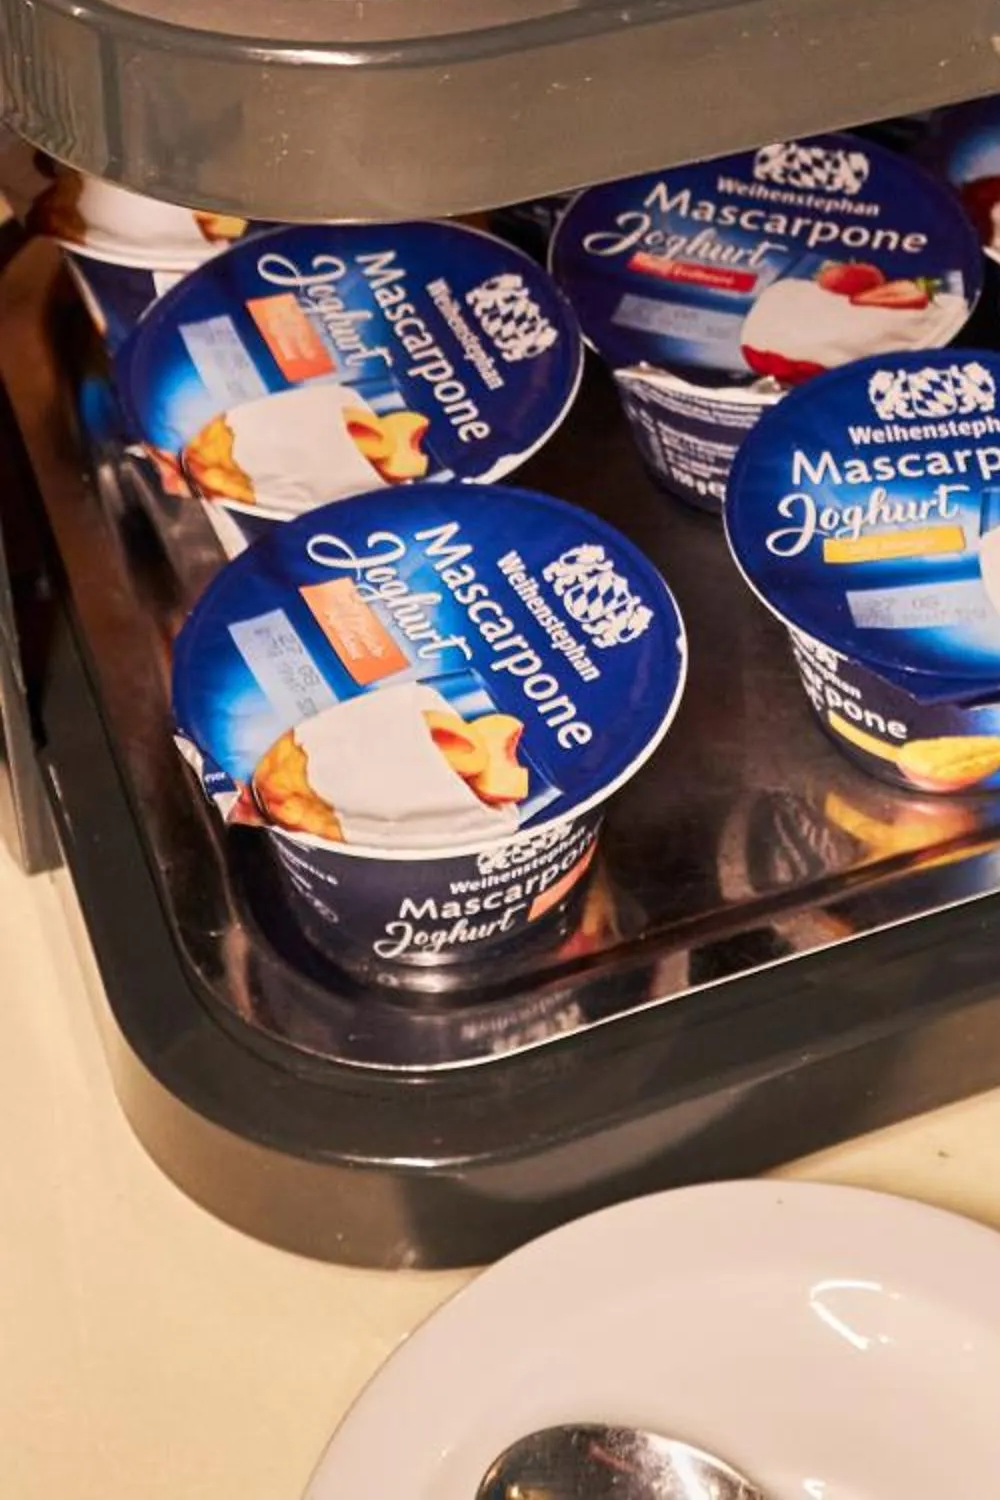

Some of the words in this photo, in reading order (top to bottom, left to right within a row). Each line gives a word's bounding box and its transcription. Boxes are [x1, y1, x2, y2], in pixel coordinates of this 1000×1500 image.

[583, 210, 789, 269] Joghurt
[642, 181, 929, 255] Mascarpone
[717, 176, 881, 218] Weihenstephan
[256, 252, 393, 370] Joghurt
[354, 250, 491, 444] Mascarpone
[765, 484, 971, 558] Joghurt
[306, 531, 474, 661] Joghurt
[414, 520, 593, 750] Mascarpone
[496, 550, 601, 683] Weihenstephan
[372, 901, 527, 960] Joghurt
